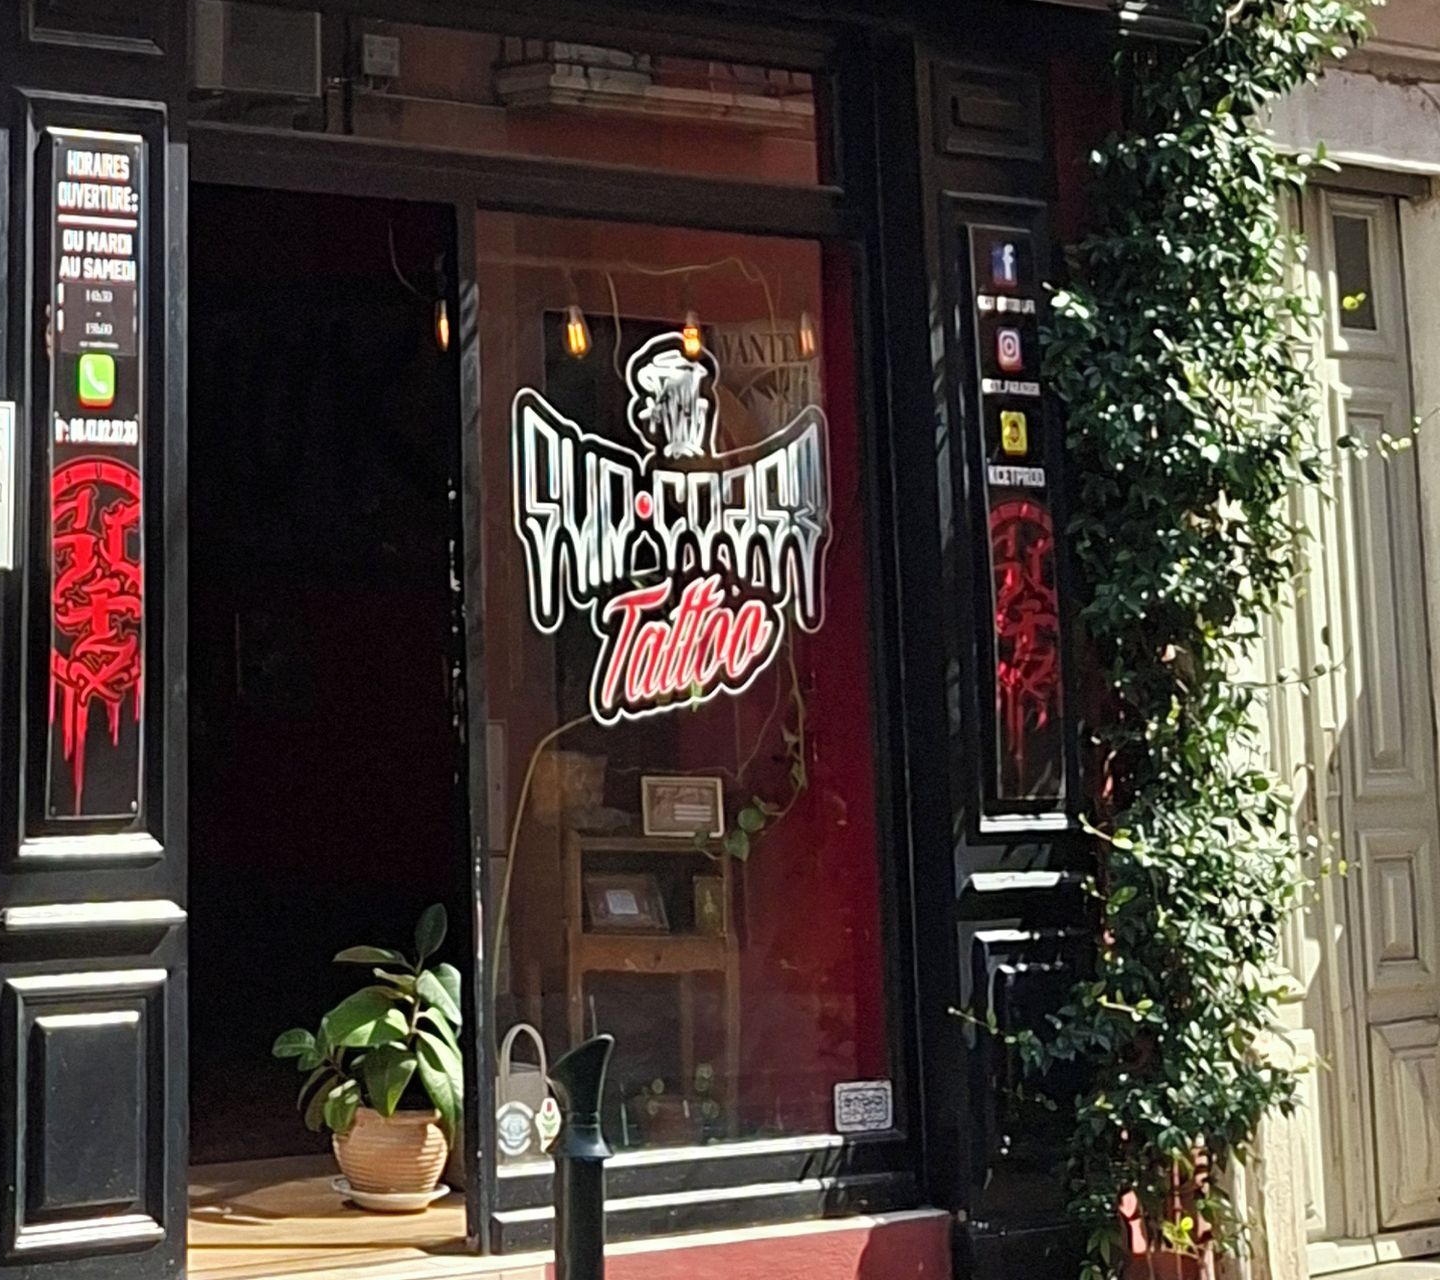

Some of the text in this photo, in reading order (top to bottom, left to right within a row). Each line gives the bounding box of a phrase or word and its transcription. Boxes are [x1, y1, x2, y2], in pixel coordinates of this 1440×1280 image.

[66, 149, 130, 180] HORAIRES
[63, 228, 133, 255] DU MARDI
[59, 255, 136, 281] AU SAMEDI
[602, 573, 773, 709] Tattoo
